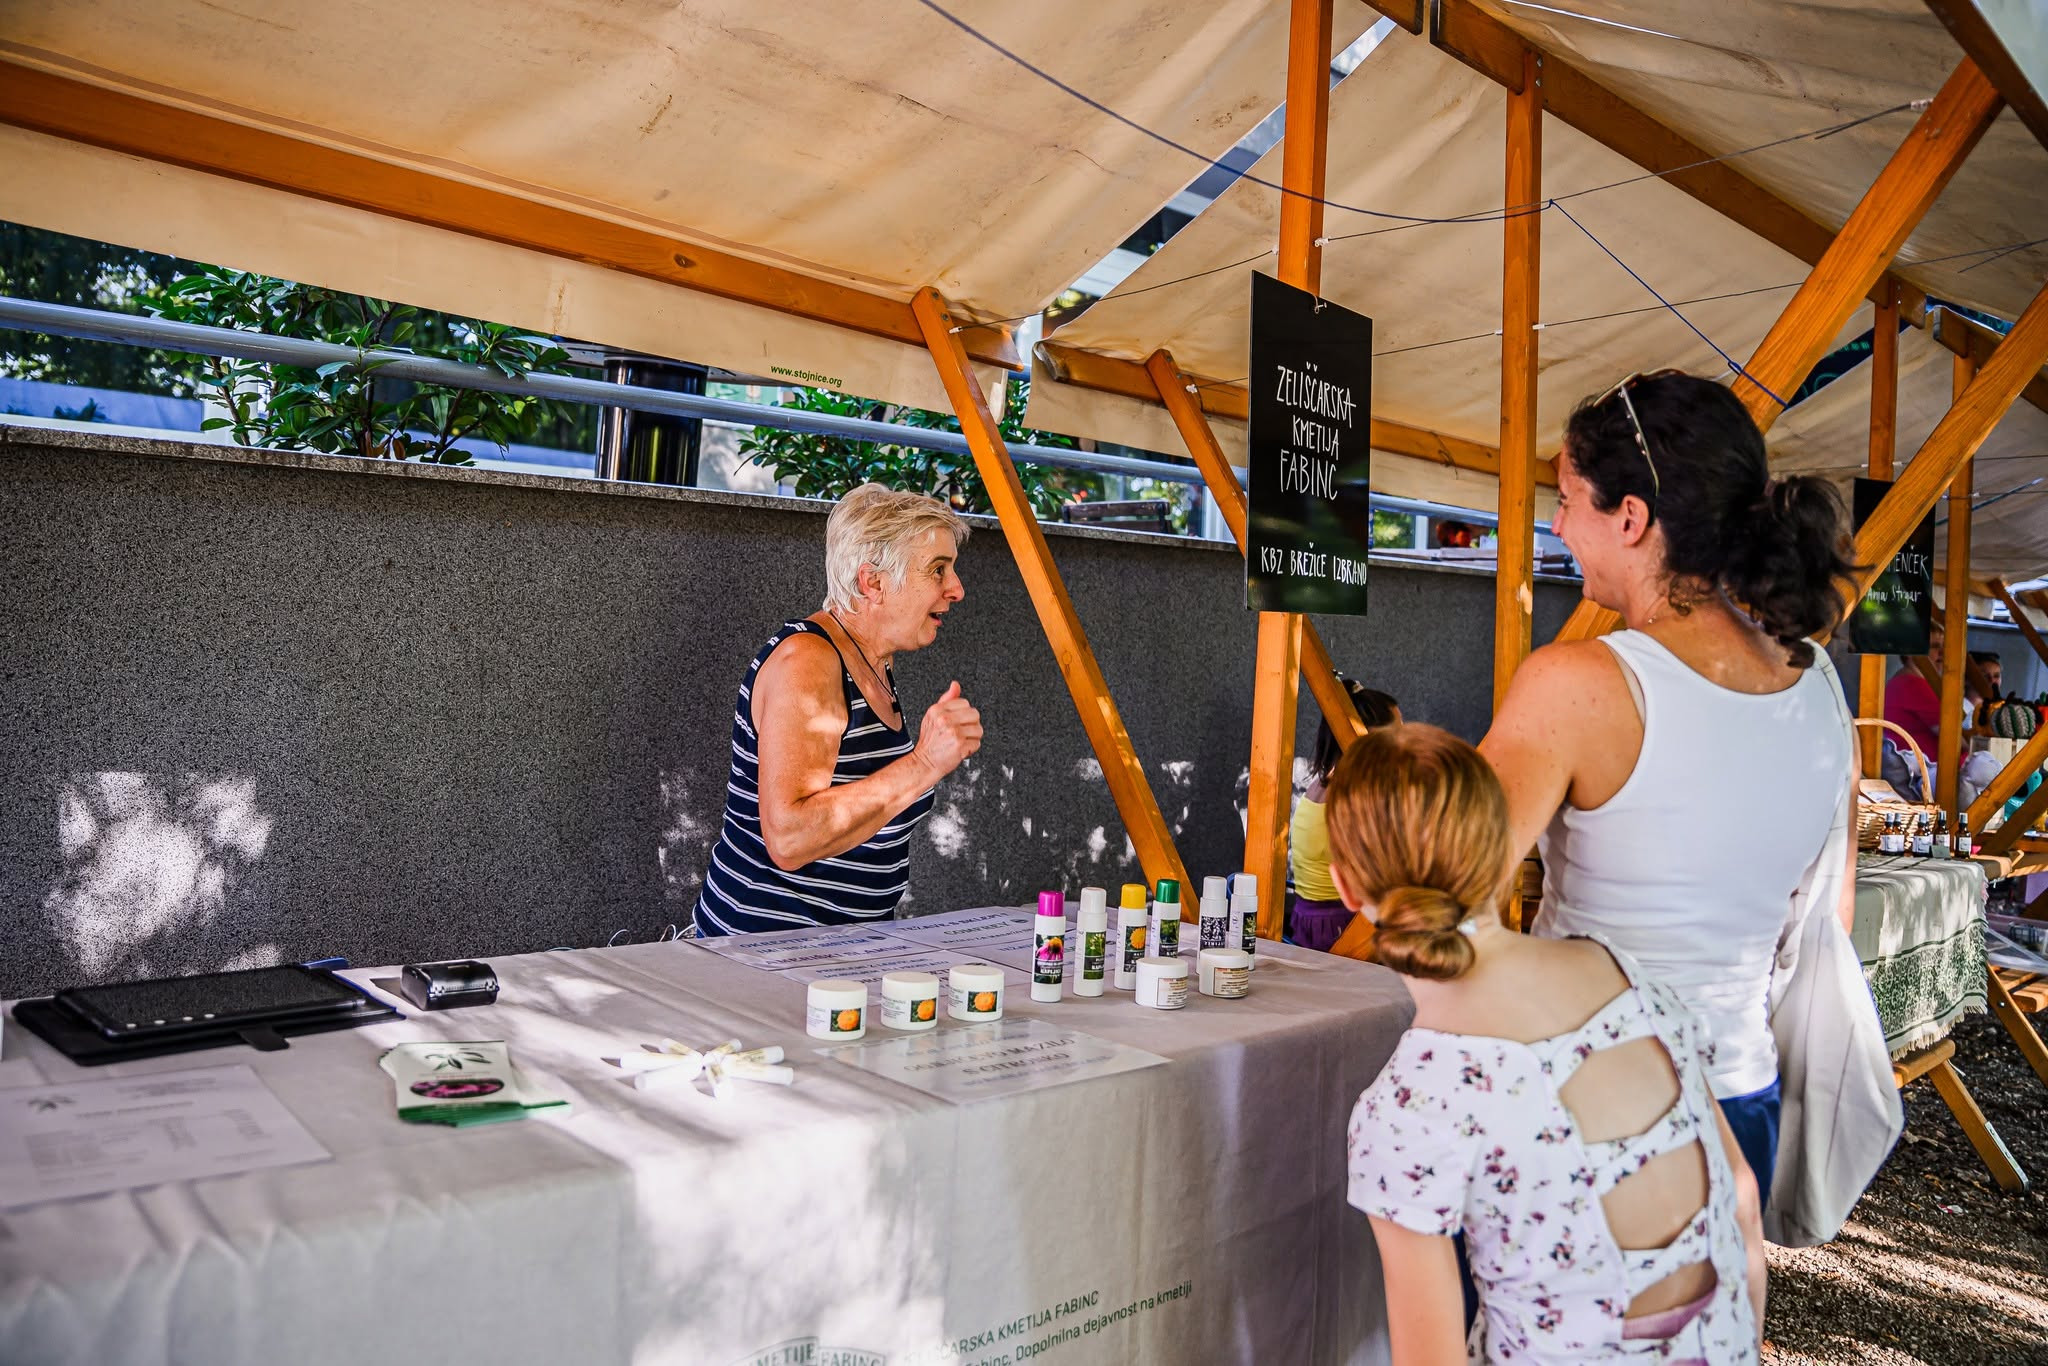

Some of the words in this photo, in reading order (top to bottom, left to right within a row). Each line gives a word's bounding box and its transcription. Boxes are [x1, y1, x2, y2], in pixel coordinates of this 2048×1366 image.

[770, 366, 842, 387] www.stojnice.org
[1292, 414, 1339, 460] KMETIJA
[1280, 449, 1338, 500] FABINC
[1260, 545, 1283, 574] KBZ
[1290, 542, 1326, 578] BREŽICE
[997, 1310, 1052, 1340] KMETIJA
[1055, 1290, 1099, 1319] FABINC
[1016, 1326, 1081, 1362] Dopolnilna
[1083, 1302, 1138, 1335] dejavnost
[1139, 1297, 1155, 1312] na
[1156, 1279, 1193, 1305] kmetiji
